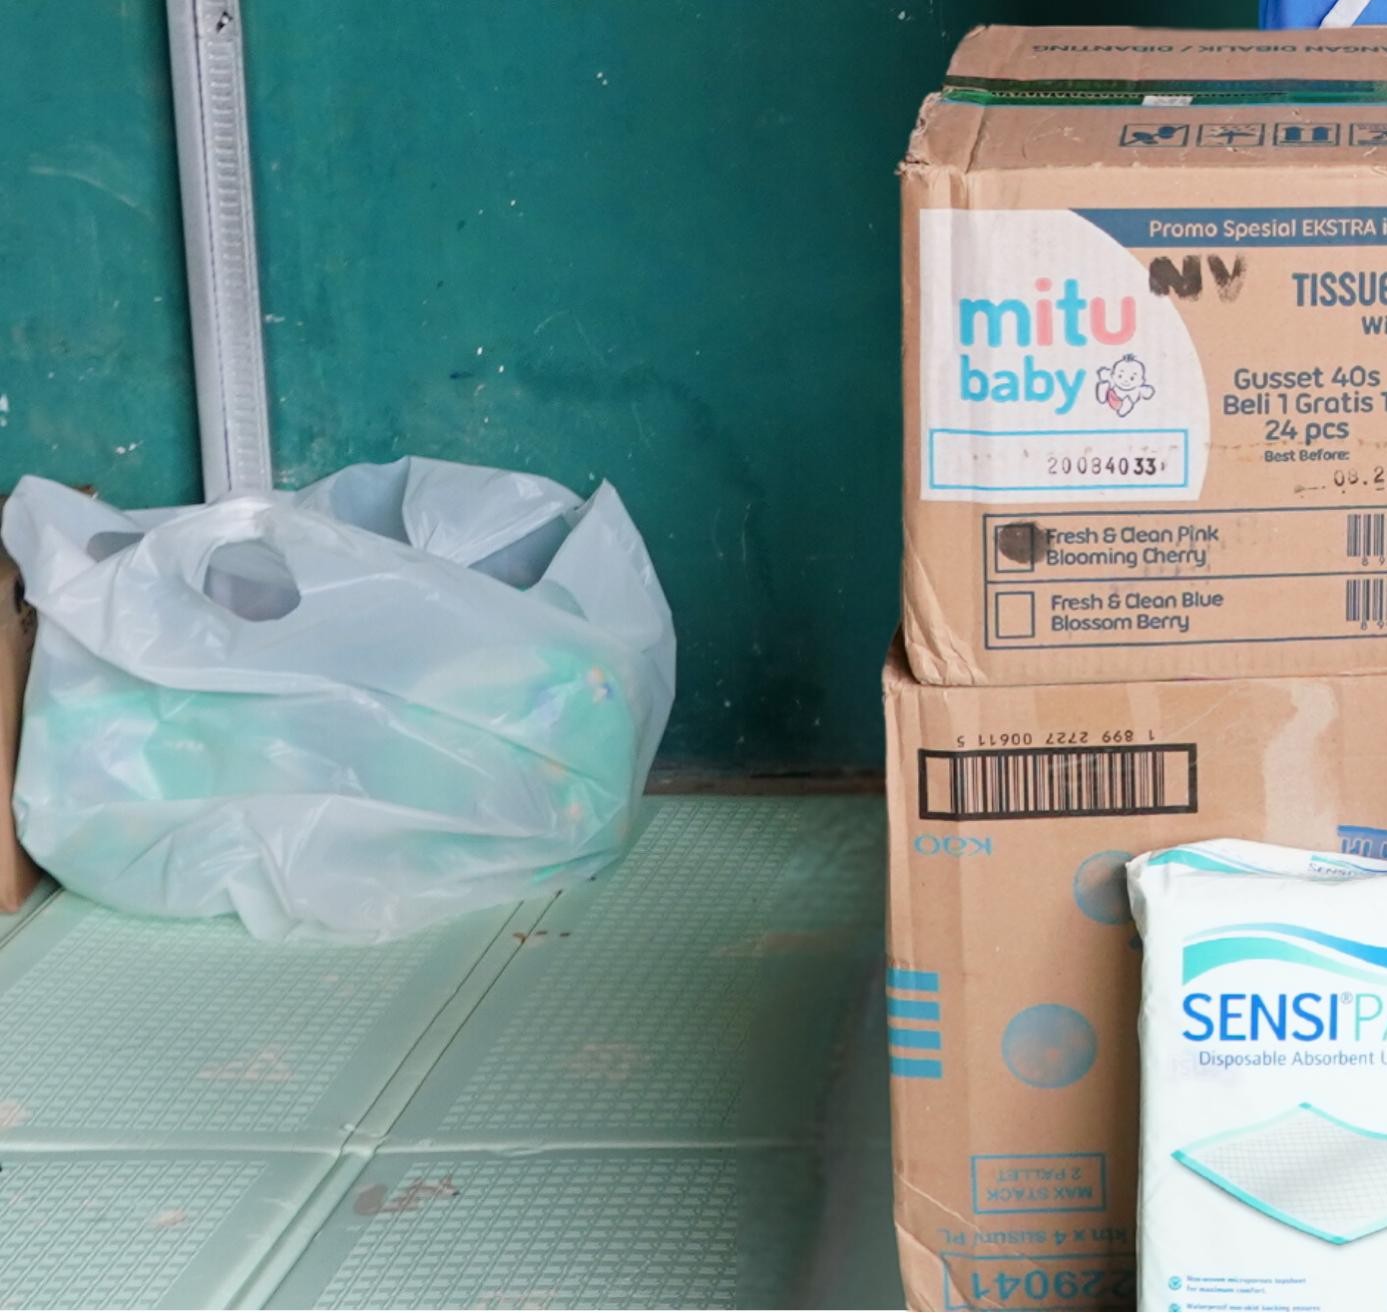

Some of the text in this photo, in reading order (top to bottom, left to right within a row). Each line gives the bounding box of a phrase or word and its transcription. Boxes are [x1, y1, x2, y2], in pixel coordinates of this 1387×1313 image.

[1149, 219, 1217, 238] Promo
[1223, 219, 1296, 240] Spesial
[1302, 219, 1377, 237] EKSTRA
[959, 277, 1136, 348] mitu
[959, 354, 1087, 415] baby
[1233, 365, 1381, 390] Gusset 40s
[1222, 391, 1374, 415] Beli Gratis
[1265, 420, 1350, 446] 24 pcs
[1264, 450, 1295, 462] Best
[1046, 525, 1219, 545] Fresh Clean Pink
[1047, 547, 1206, 569] Blooming Cherry
[1051, 592, 1224, 611] Fresh Clean Blue
[1051, 613, 1190, 633] Blossom Berry
[977, 730, 1134, 746] 899 2727 00611
[1199, 1050, 1287, 1069] Disposable
[1291, 1050, 1375, 1067] Absorbent
[986, 1188, 1049, 1202] STACK
